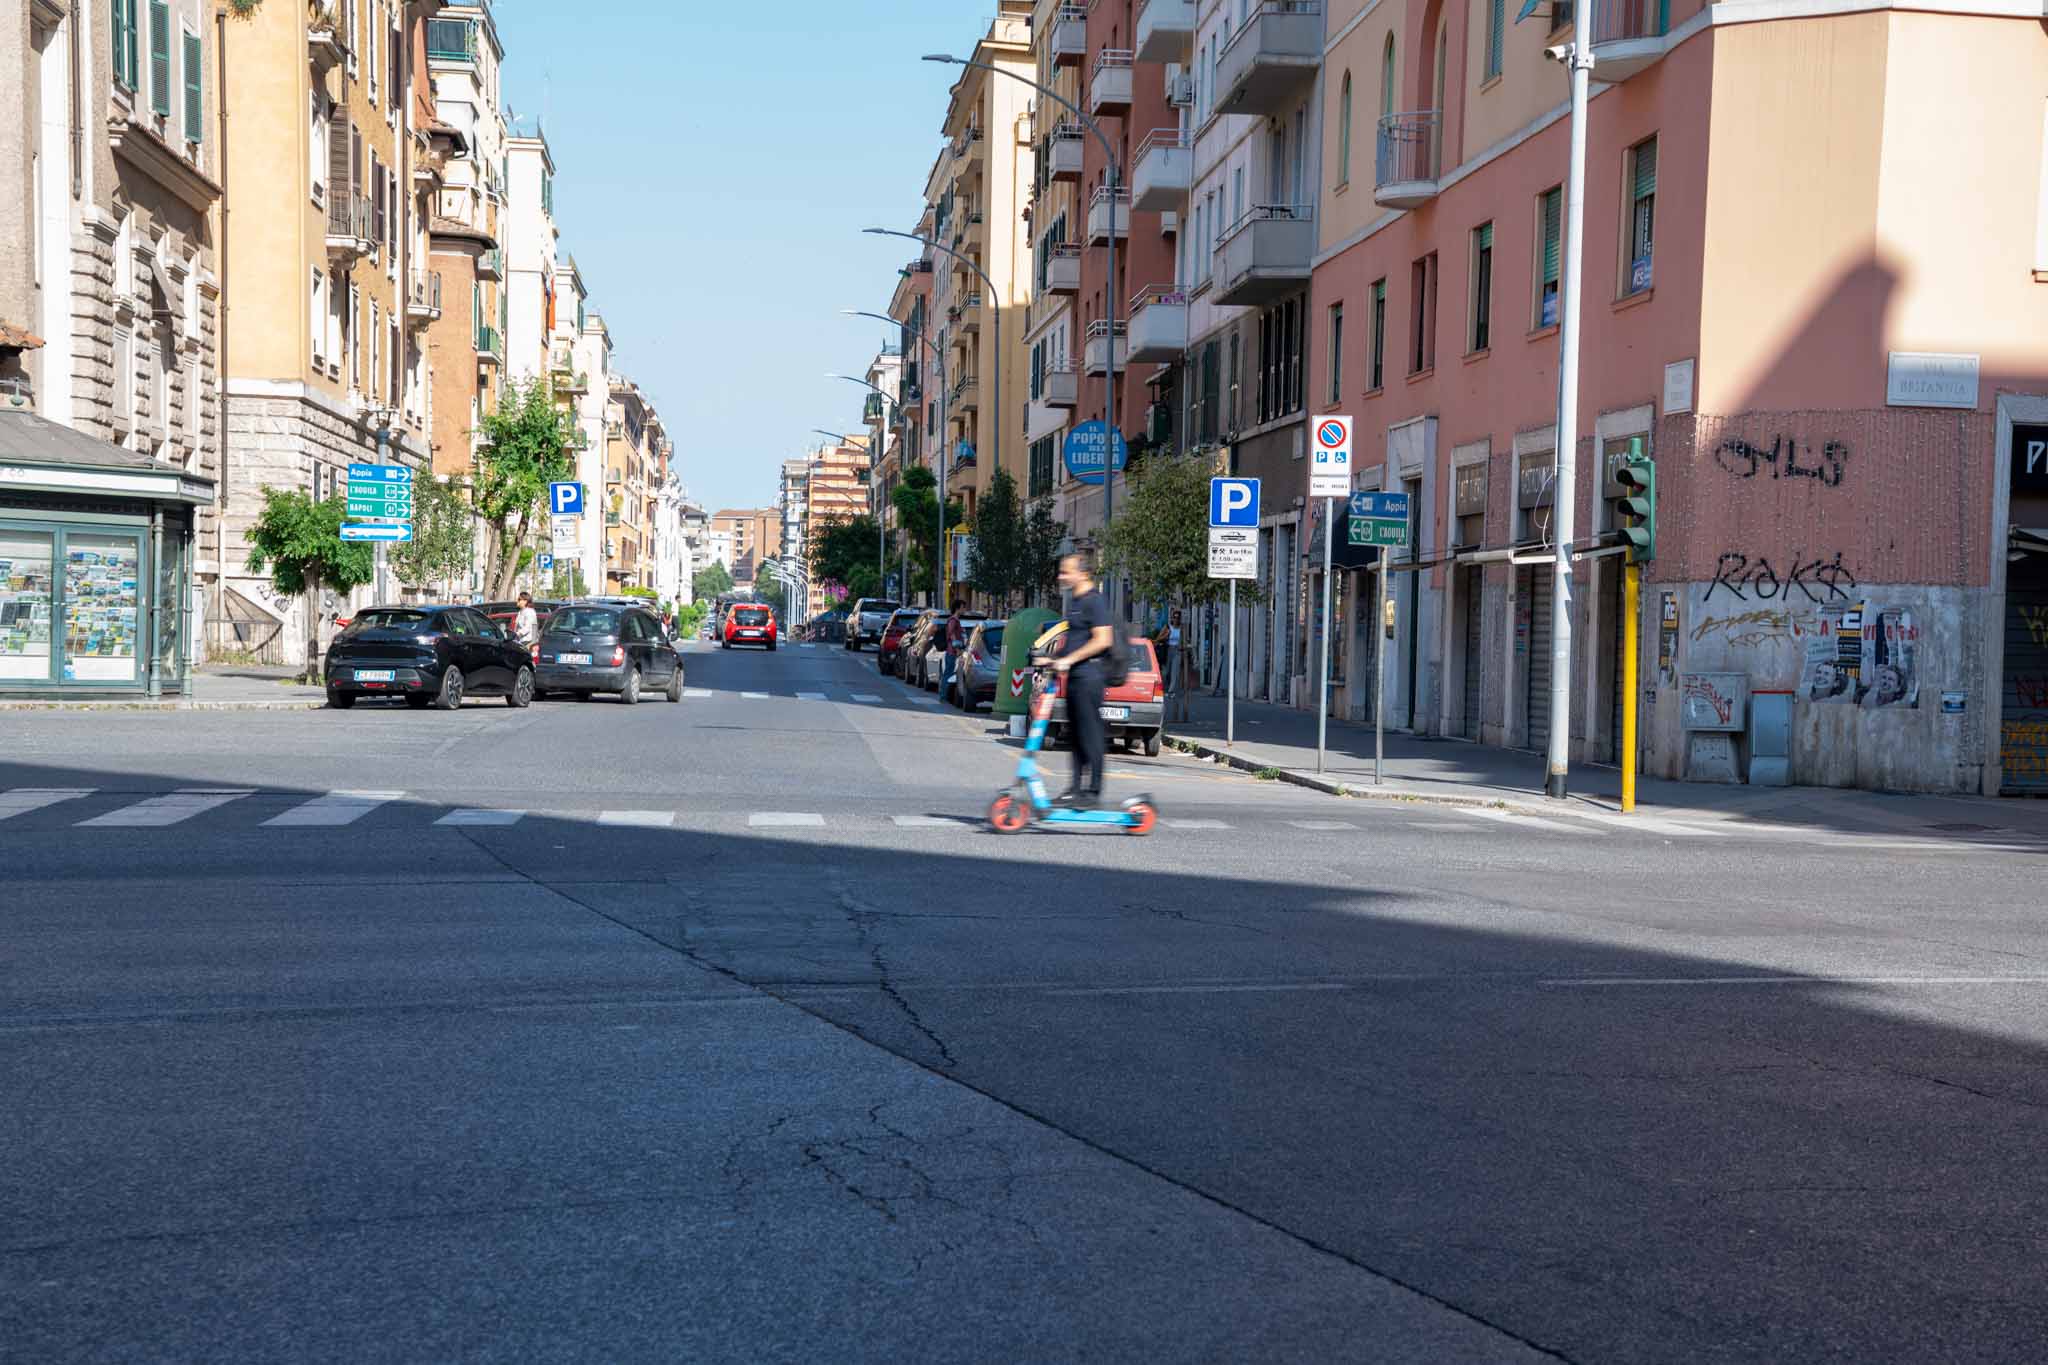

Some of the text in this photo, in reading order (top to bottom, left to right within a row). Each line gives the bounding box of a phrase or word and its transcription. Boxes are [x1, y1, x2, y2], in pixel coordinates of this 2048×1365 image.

[1072, 432, 1119, 445] POPOO
[1072, 452, 1120, 465] LIBERA
[350, 468, 373, 478] Appia
[557, 485, 577, 512] P
[1220, 482, 1252, 523] P
[349, 503, 373, 513] NAPOLI
[1385, 499, 1406, 512] Appia
[1379, 527, 1405, 538] L'AQUILA
[540, 555, 551, 568] P
